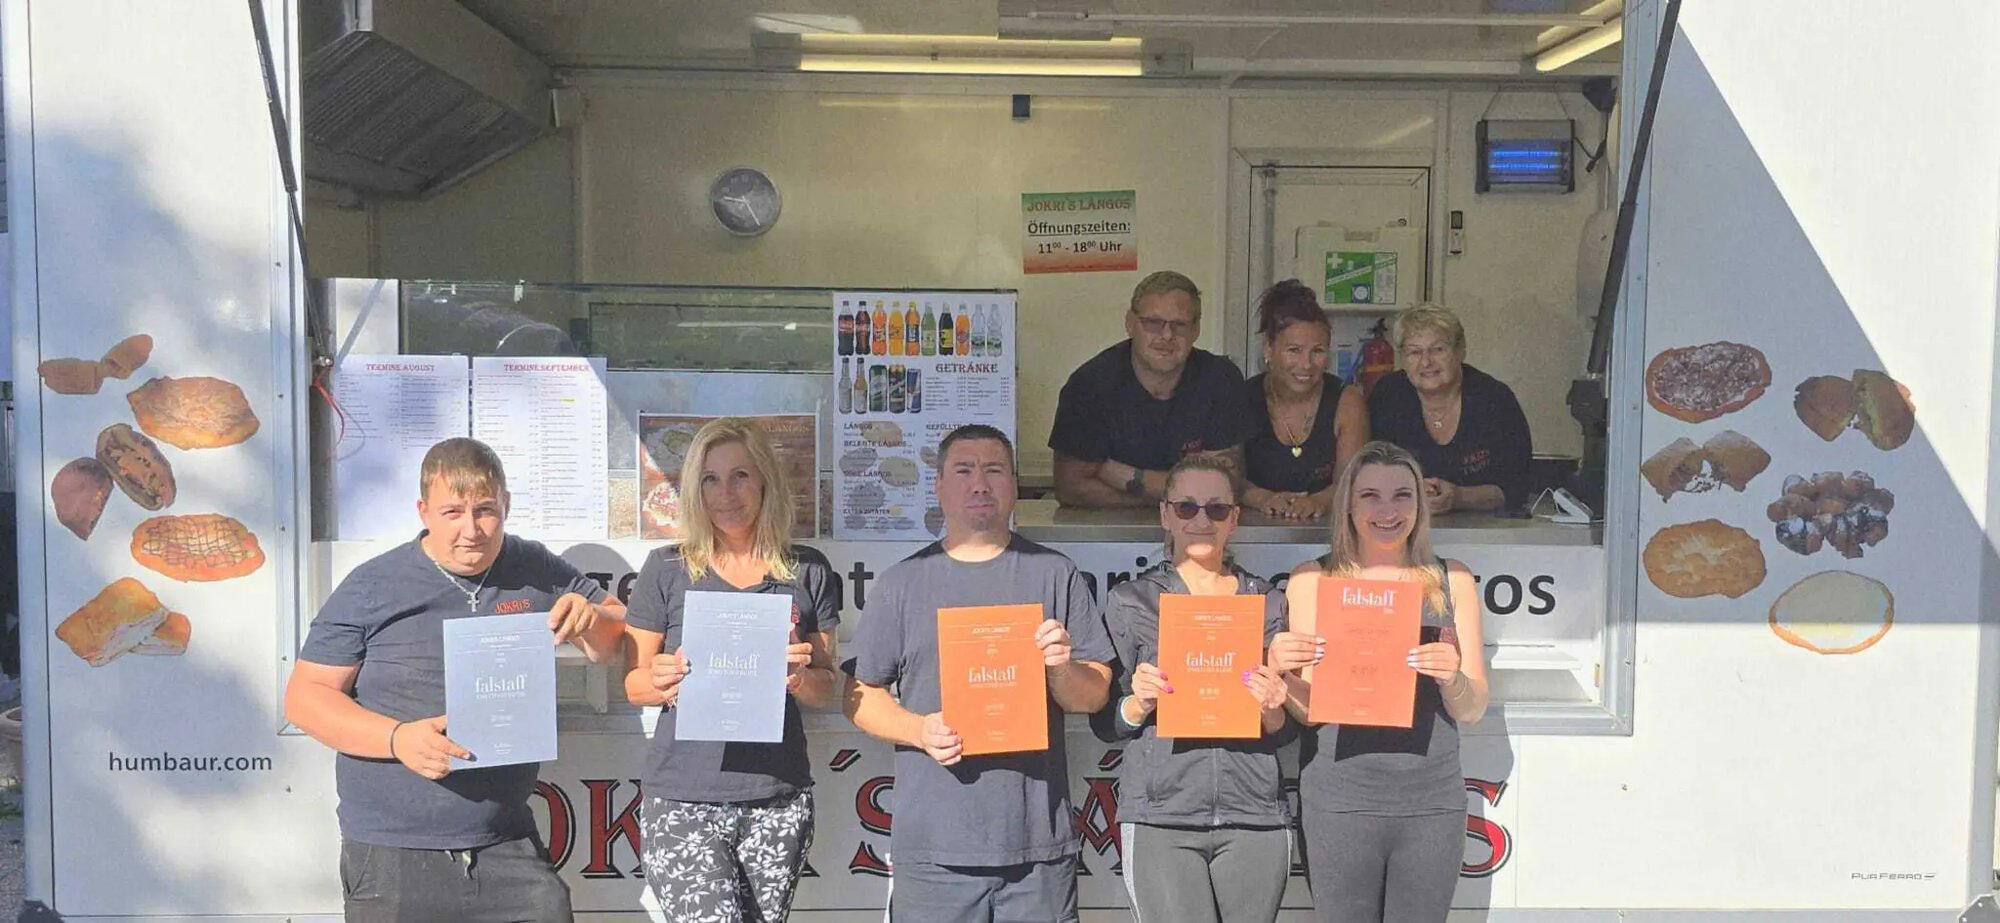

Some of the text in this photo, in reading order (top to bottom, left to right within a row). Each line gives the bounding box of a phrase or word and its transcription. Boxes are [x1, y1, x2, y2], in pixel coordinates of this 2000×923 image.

[1028, 219, 1131, 236] Öffnungszeiten:
[1099, 241, 1122, 253] Uhr
[366, 363, 435, 372] TERMINE AUGUST
[504, 363, 538, 373] TERMINE
[1342, 585, 1398, 607] falstaff
[708, 651, 760, 669] falstaff
[1185, 651, 1236, 668] falstaff
[967, 664, 1017, 683] falstaff
[474, 673, 528, 693] falstaff
[109, 751, 273, 771] humbaur.com
